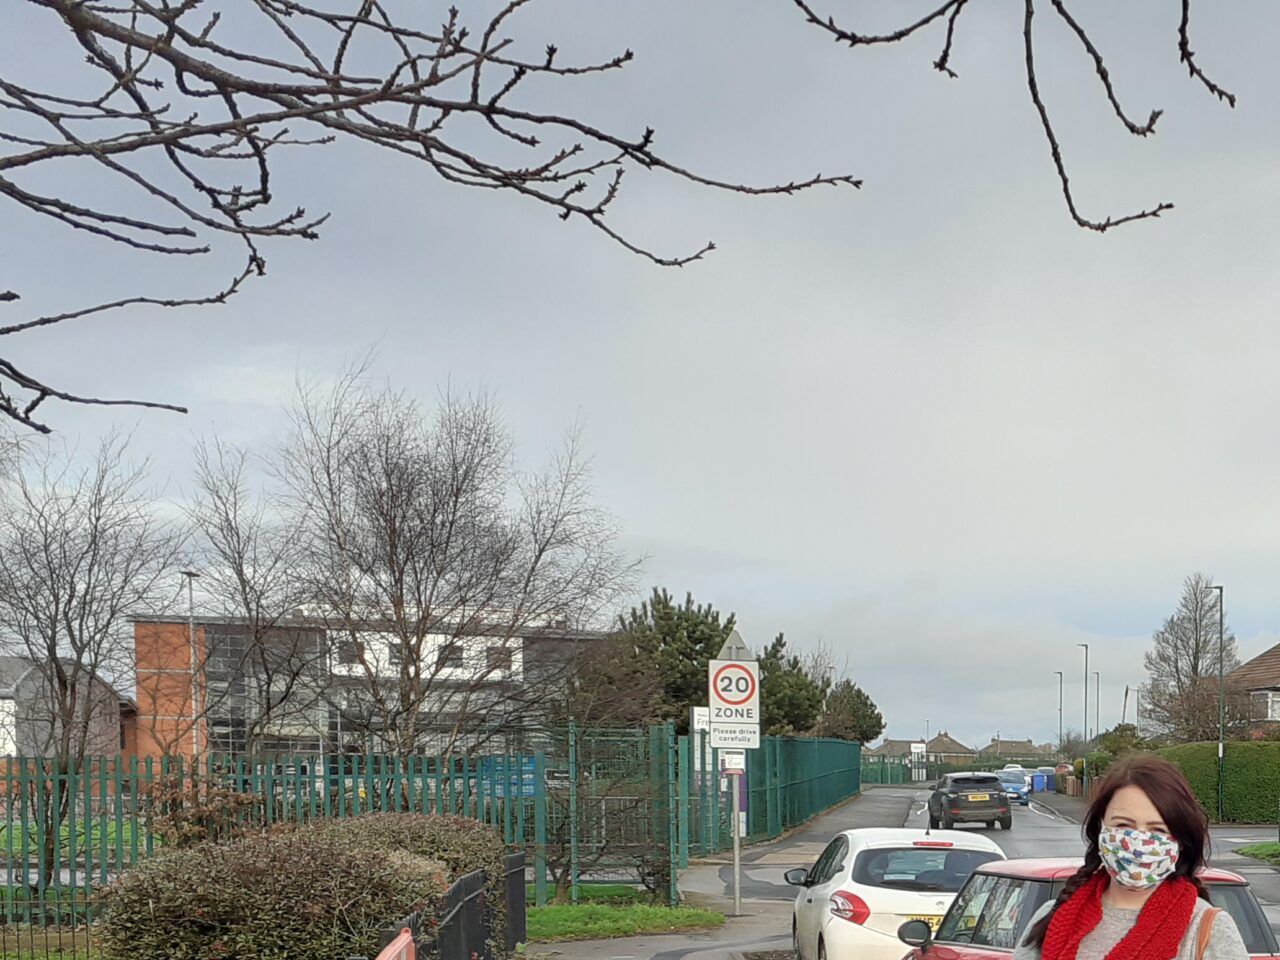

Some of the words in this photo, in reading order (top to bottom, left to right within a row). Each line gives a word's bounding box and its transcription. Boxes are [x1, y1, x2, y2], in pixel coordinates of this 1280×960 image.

[719, 676, 749, 693] 20
[715, 707, 754, 719] ZONE
[713, 727, 737, 735] Please
